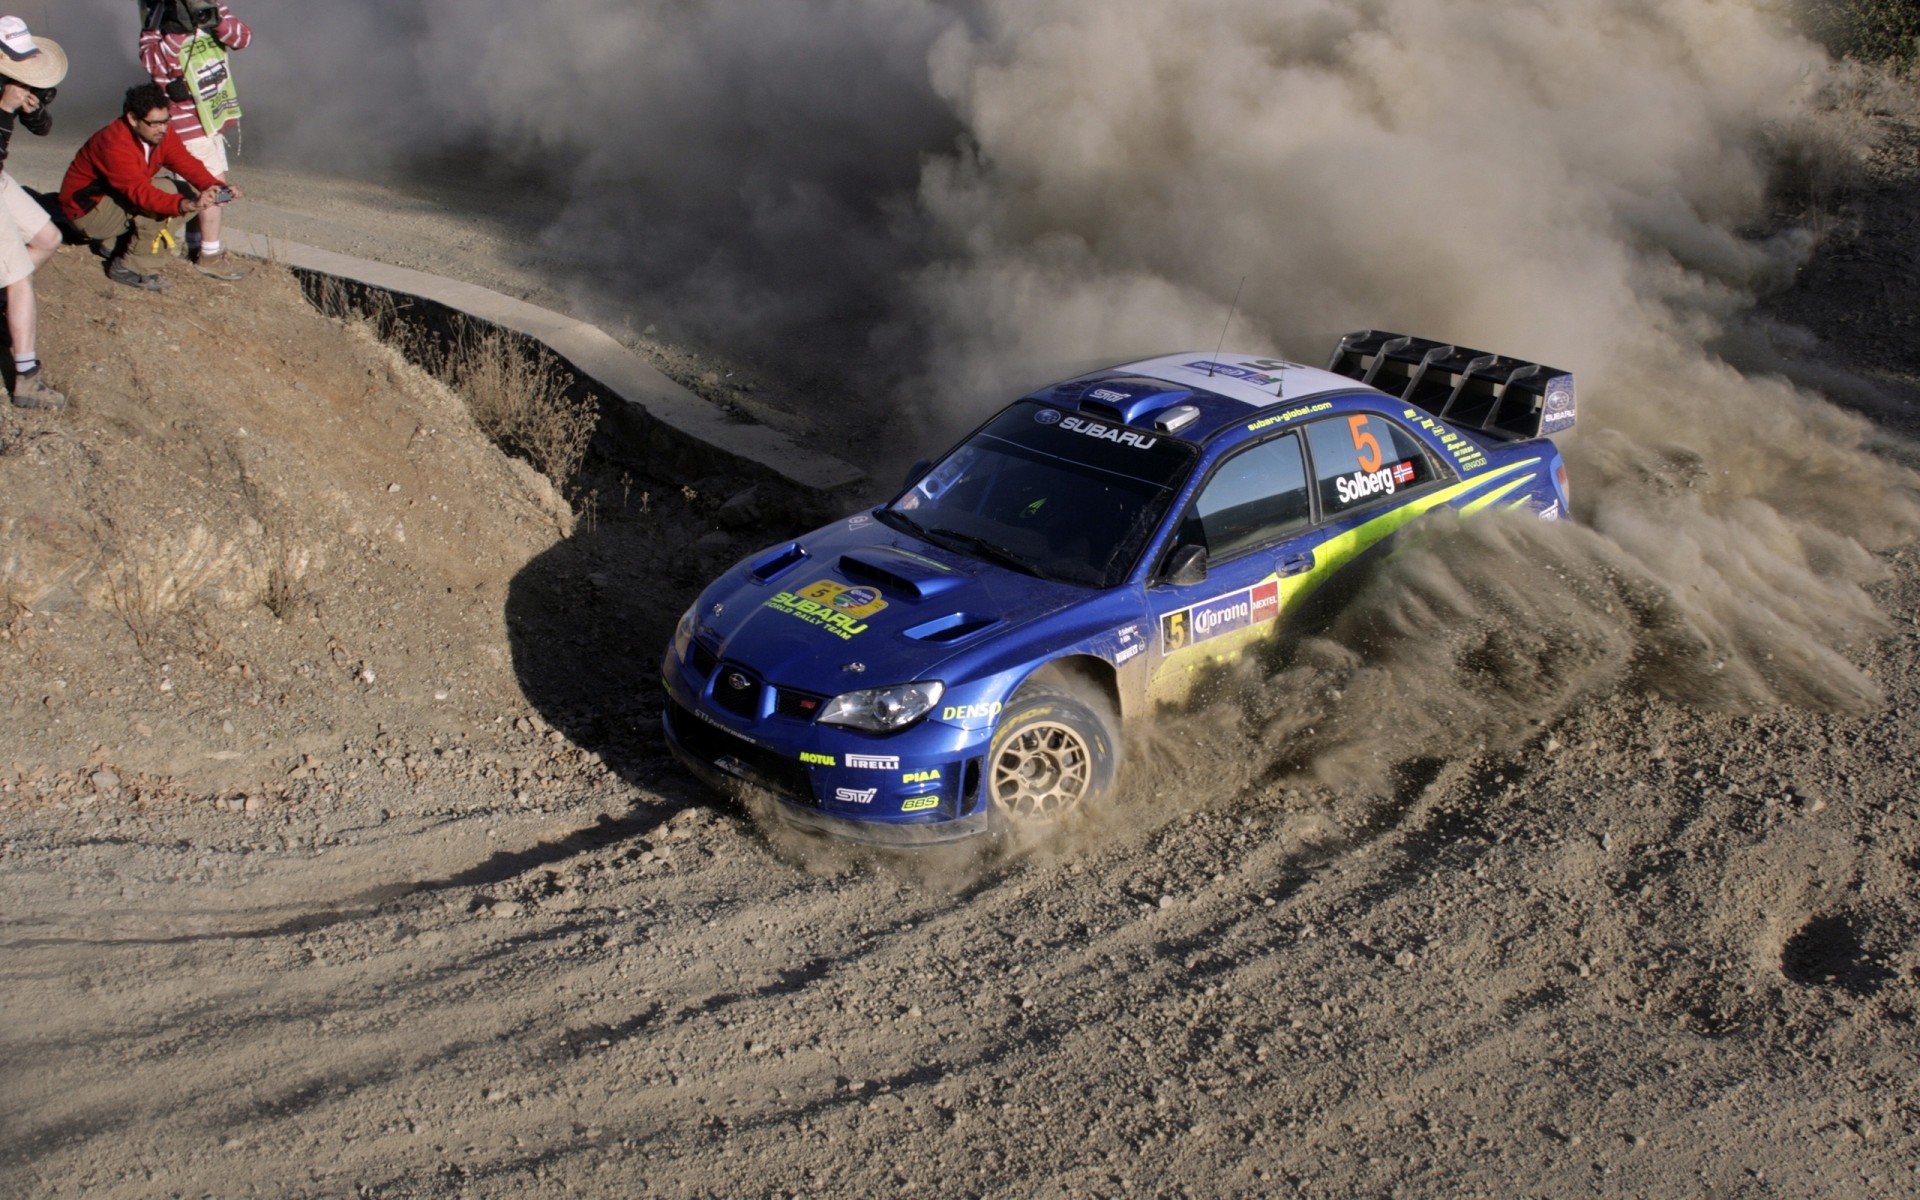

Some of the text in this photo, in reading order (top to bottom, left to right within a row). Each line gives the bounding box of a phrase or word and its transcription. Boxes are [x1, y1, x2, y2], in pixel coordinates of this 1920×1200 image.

[1247, 402, 1332, 431] subaru-global.com
[1545, 410, 1575, 422] SUBARU
[1059, 416, 1157, 449] SUBARU
[1348, 413, 1382, 474] 5
[1336, 467, 1395, 503] Solberg
[811, 588, 830, 598] 5
[770, 592, 868, 634] SUBARU
[793, 608, 823, 625] RALLY
[824, 623, 852, 640] TEAM
[1171, 596, 1277, 649] 5 Corona NEXTEL
[943, 702, 1002, 720] DENSO
[800, 752, 900, 770] MOTUL PIRELLI
[903, 769, 940, 784] PIAA
[903, 797, 938, 809] BBS
